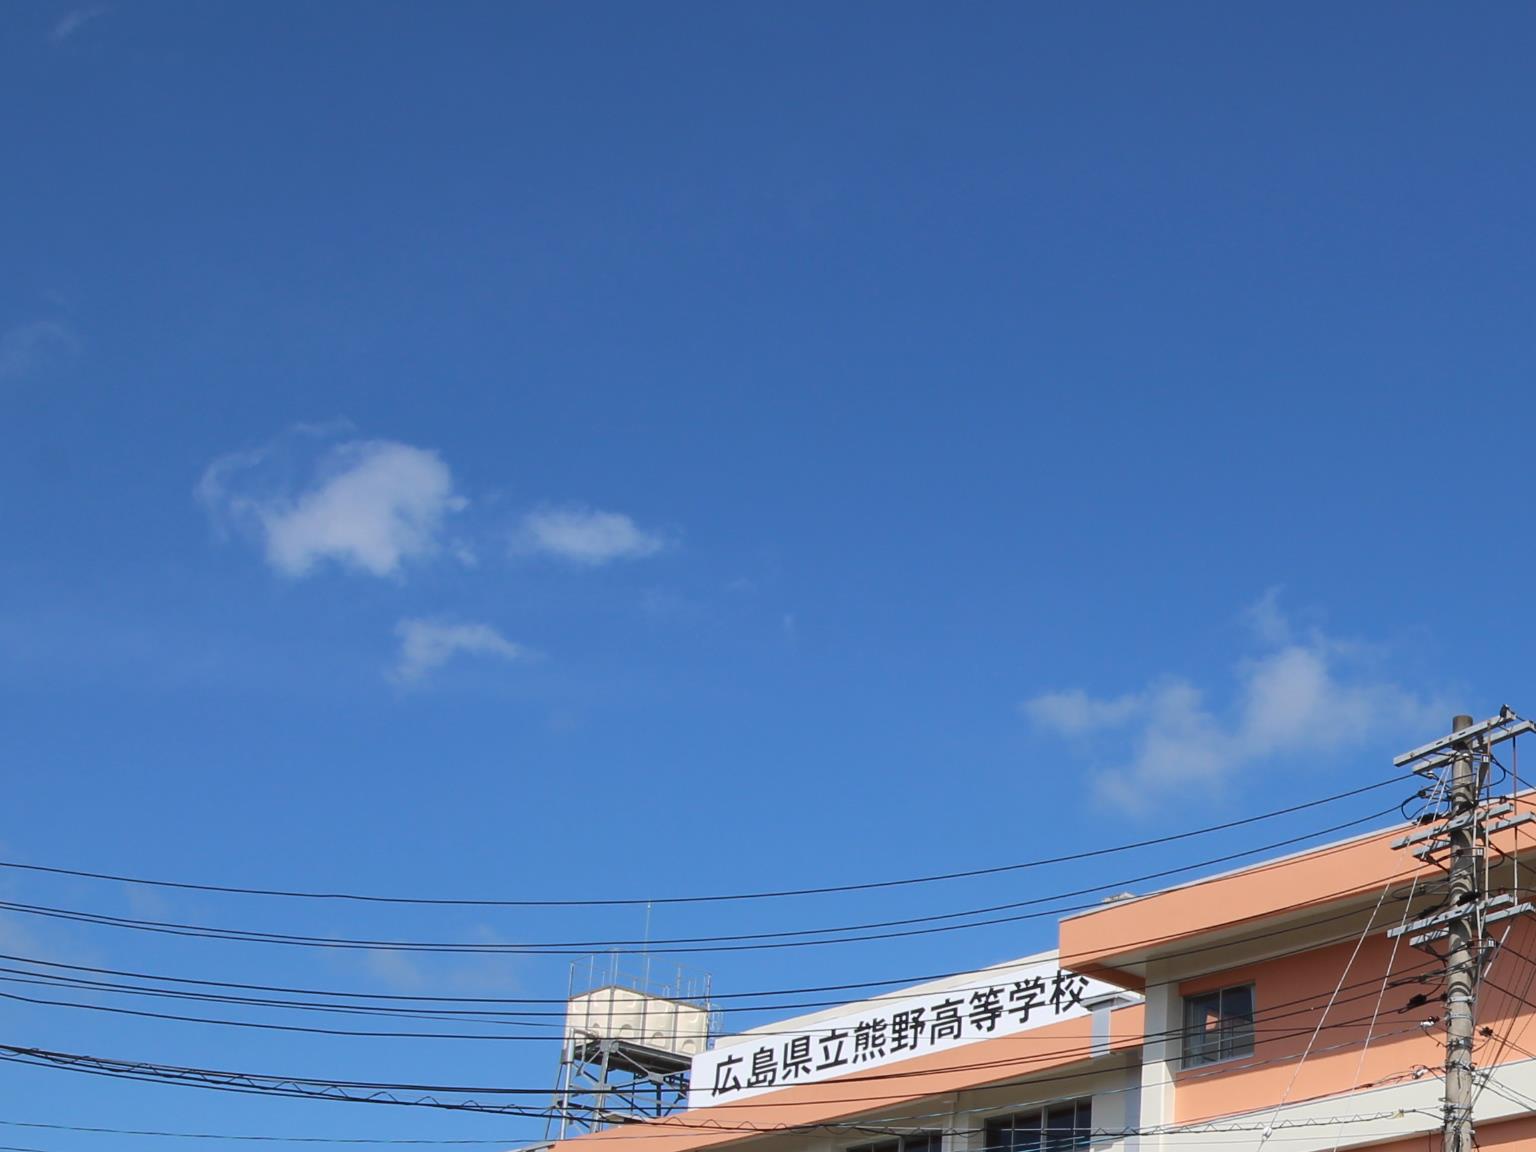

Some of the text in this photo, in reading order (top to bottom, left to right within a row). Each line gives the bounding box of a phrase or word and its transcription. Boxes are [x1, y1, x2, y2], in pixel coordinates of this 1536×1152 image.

[711, 968, 1090, 1097] 広島県立熊野高等学校
